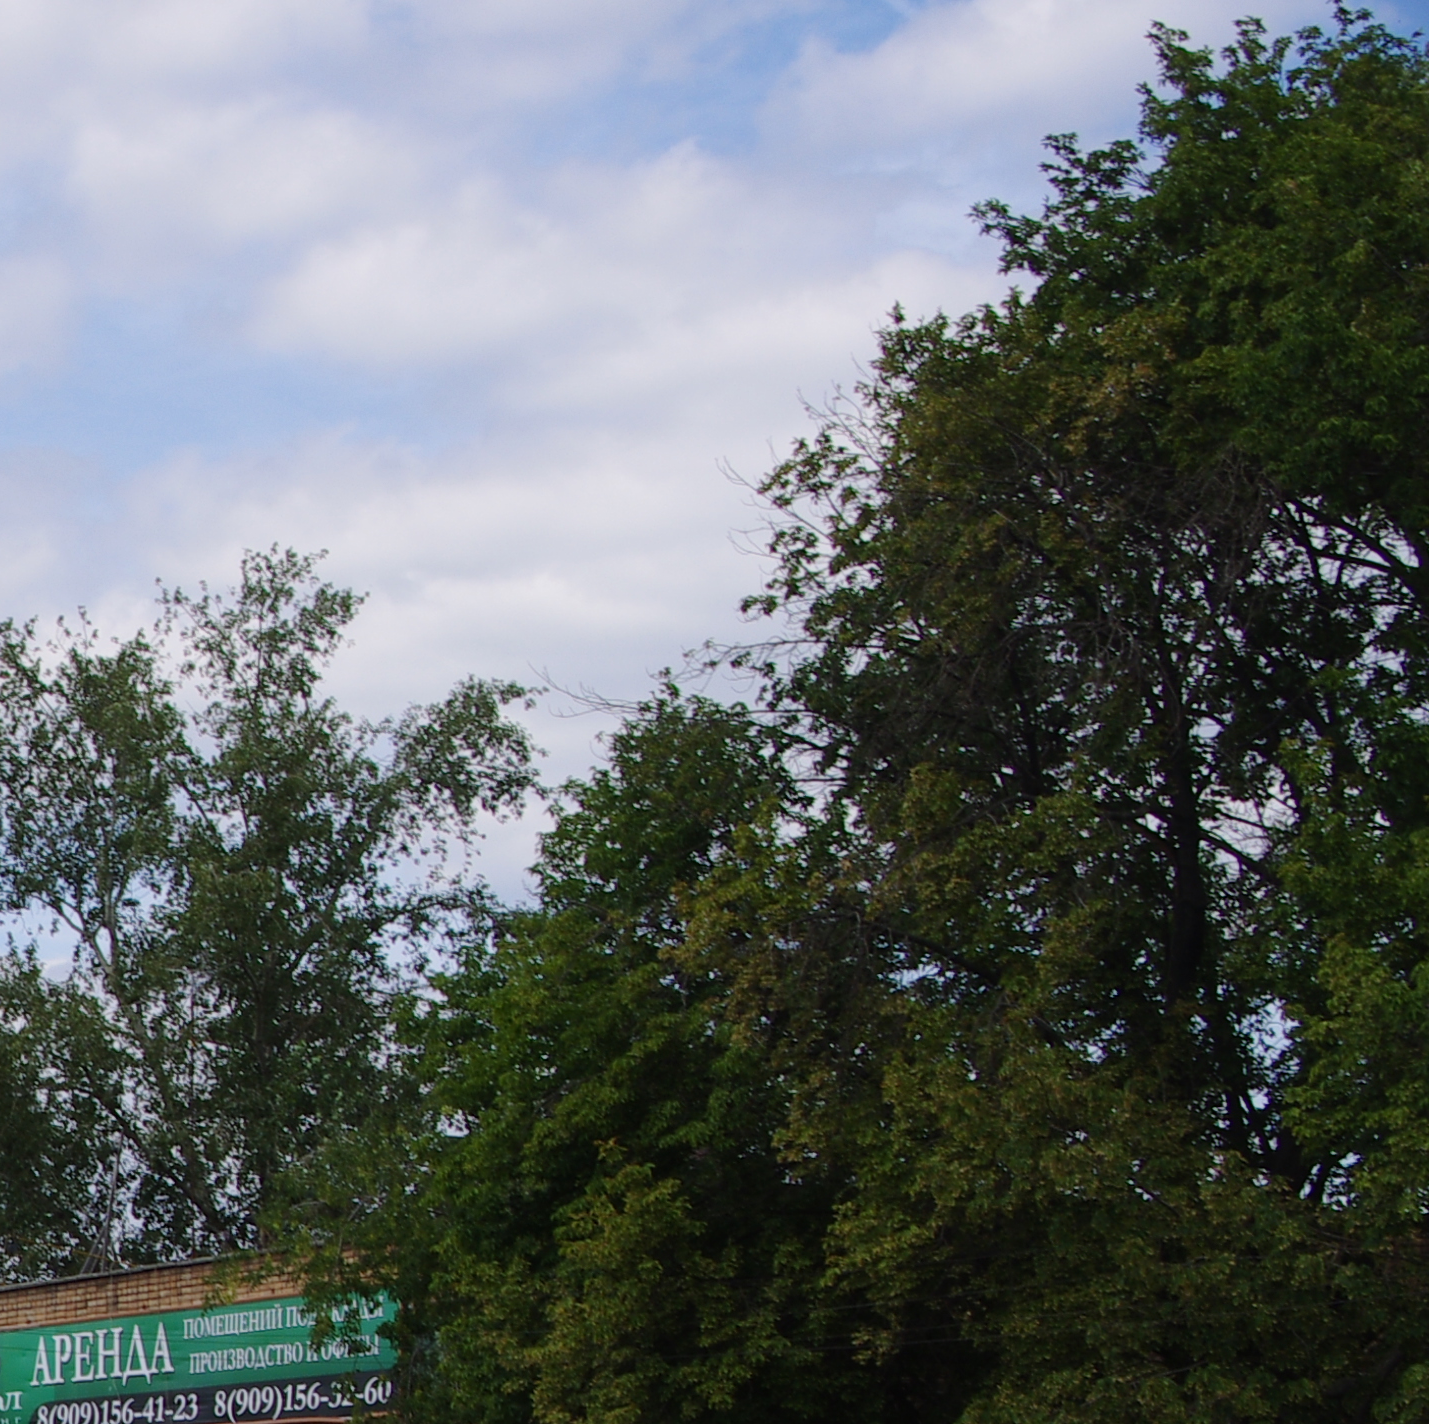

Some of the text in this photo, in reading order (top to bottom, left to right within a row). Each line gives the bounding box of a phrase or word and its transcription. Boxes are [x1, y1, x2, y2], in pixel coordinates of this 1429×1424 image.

[183, 1304, 284, 1339] ПОМЕЩЕНИЙ
[30, 1321, 174, 1386] АРЕНДА
[189, 1341, 301, 1374] ПРОИЗВОДСТВО
